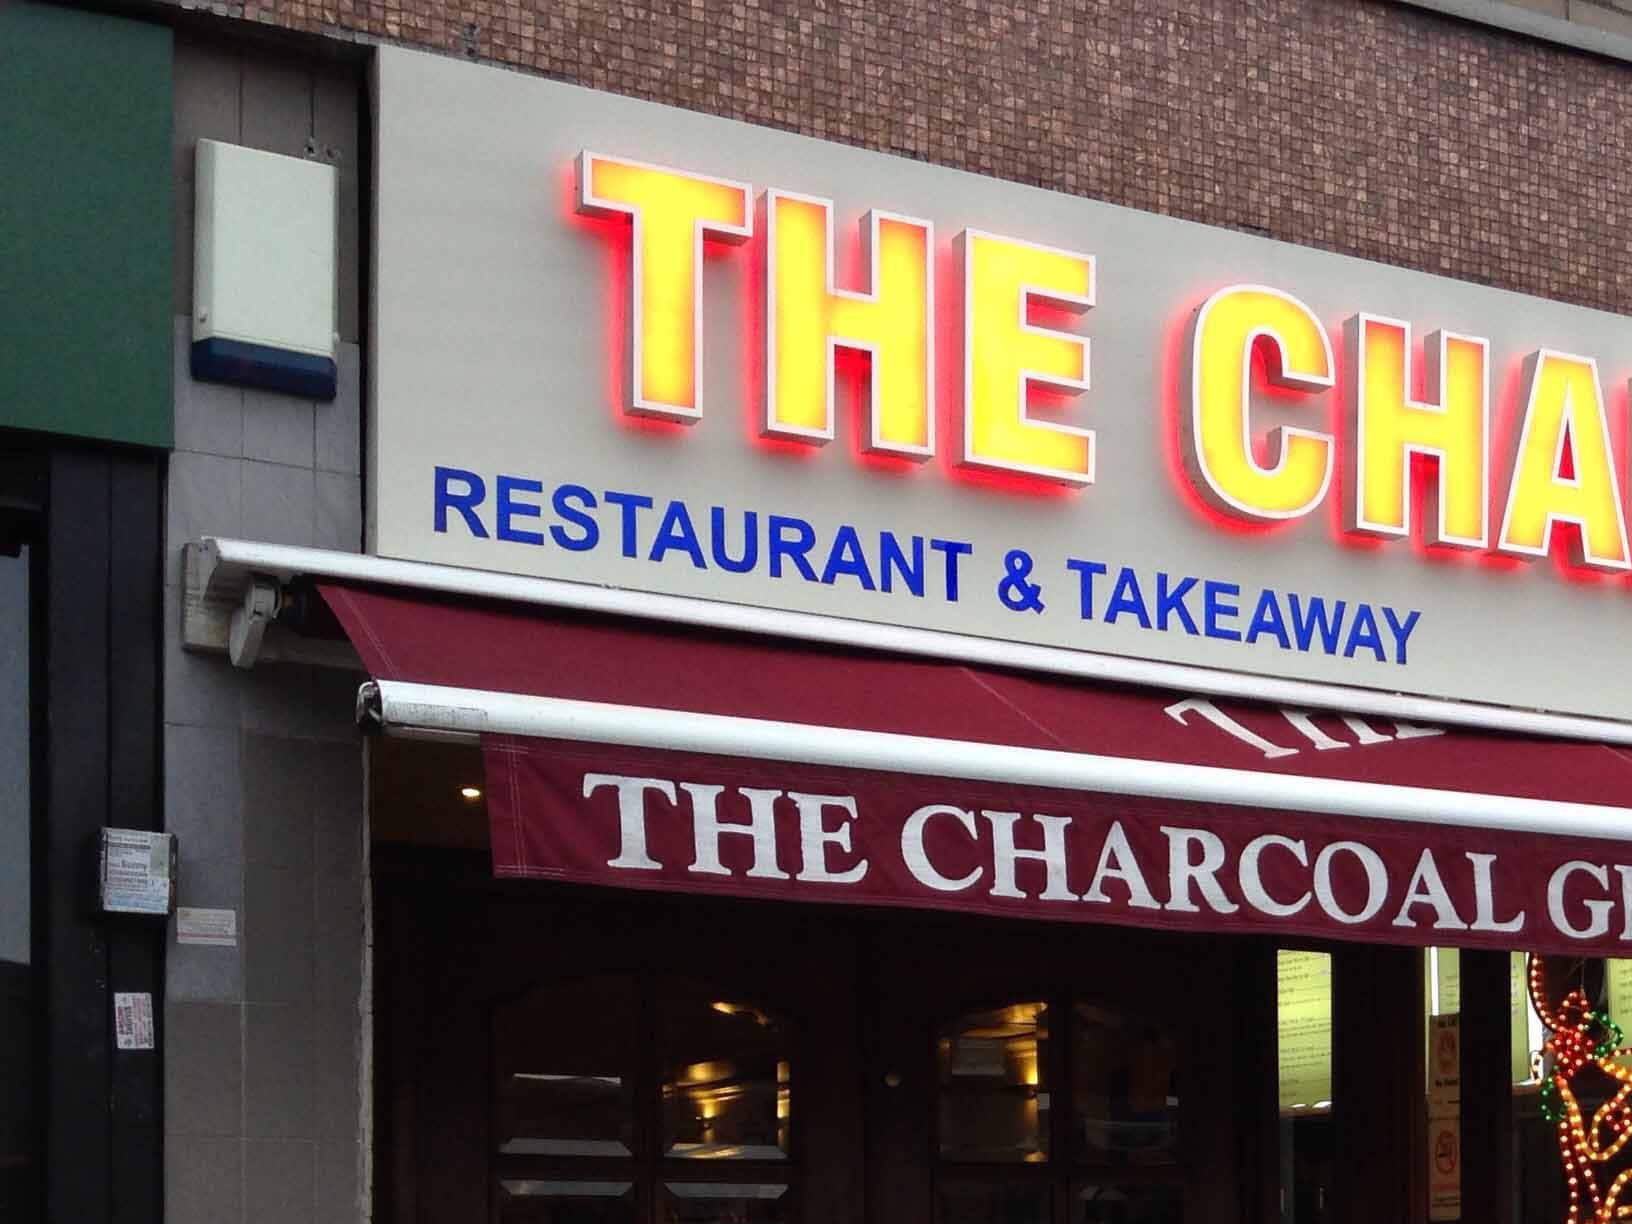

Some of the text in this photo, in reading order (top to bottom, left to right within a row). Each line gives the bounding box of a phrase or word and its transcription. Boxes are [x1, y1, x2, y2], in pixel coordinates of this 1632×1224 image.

[574, 149, 1097, 489] THE
[432, 466, 1422, 666] RESTAURANT & TAKEAWAY
[583, 772, 868, 884] THE
[901, 803, 1525, 932] CHARCOAL
